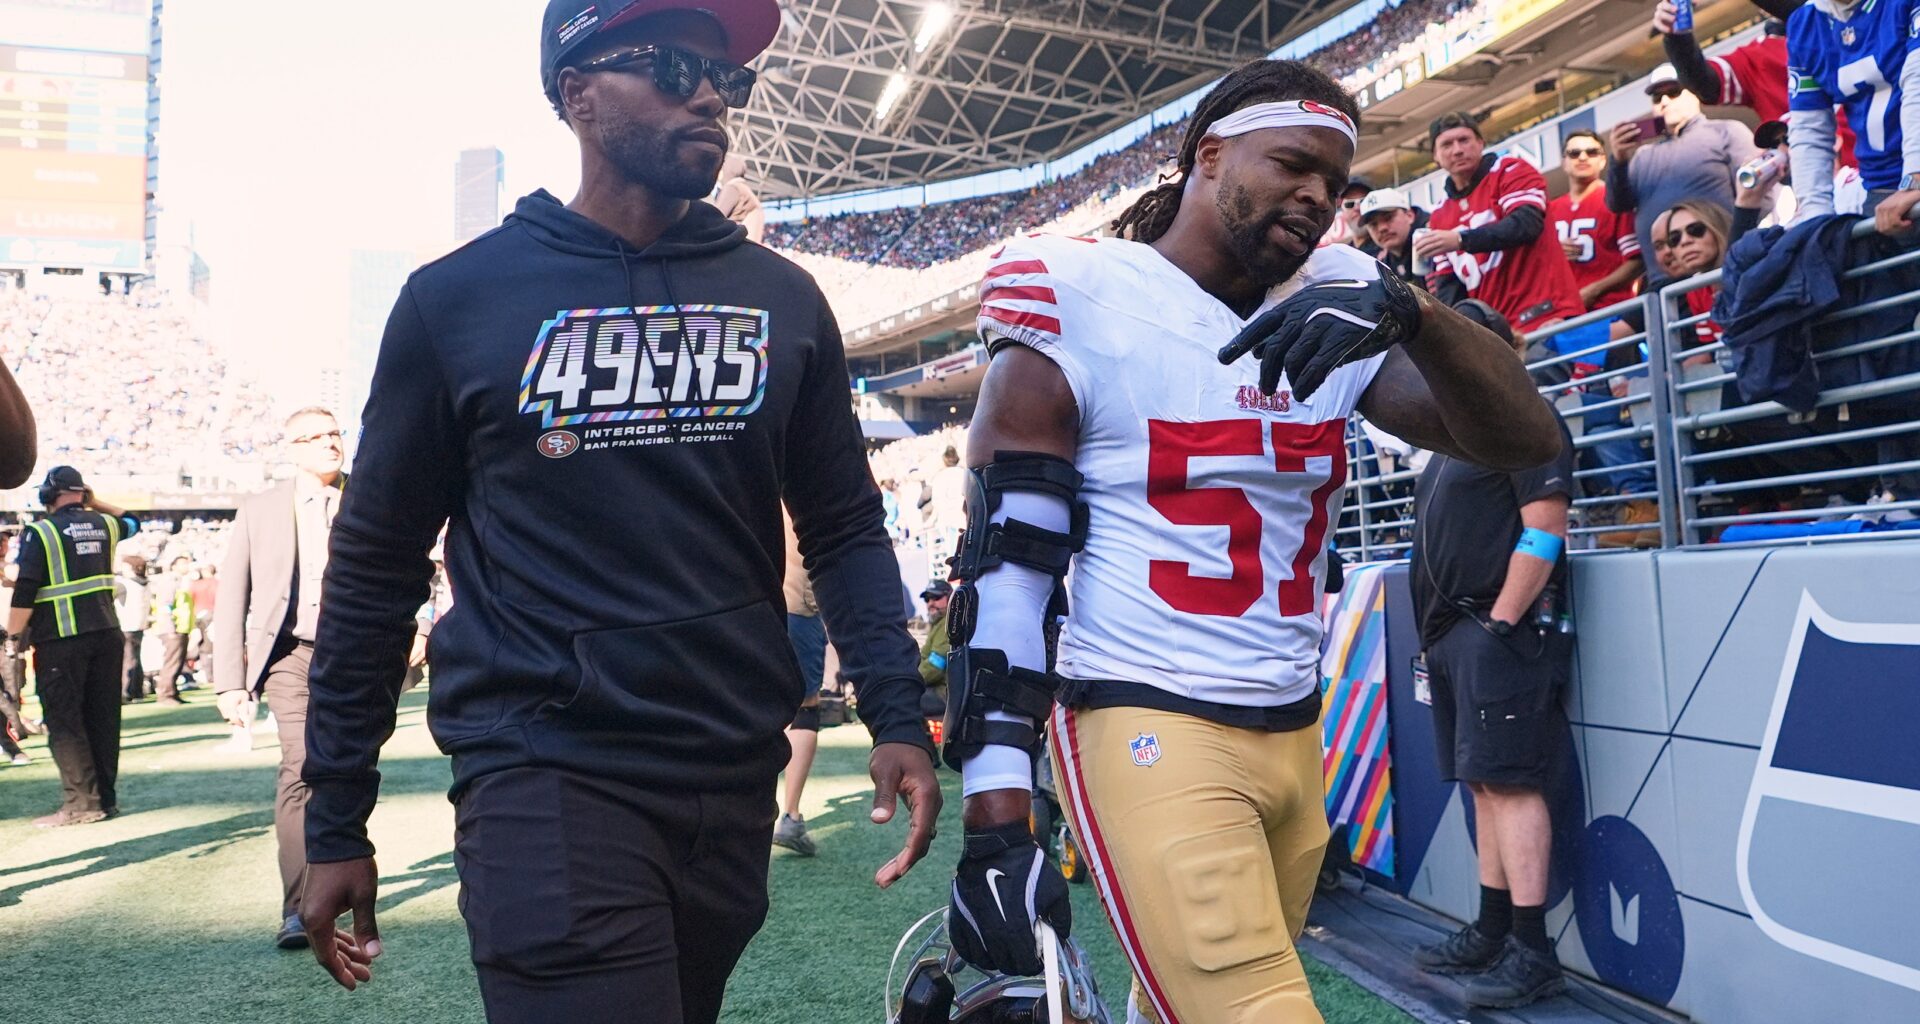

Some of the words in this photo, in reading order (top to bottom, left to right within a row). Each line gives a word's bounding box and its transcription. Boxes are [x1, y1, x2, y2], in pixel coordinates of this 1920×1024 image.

[1837, 55, 1892, 152] 7
[536, 316, 757, 410] 49ERS
[584, 441, 609, 450] SAN
[680, 434, 734, 443] FOOTBALL
[681, 422, 746, 432] CANCER
[1147, 418, 1347, 618] 57
[1136, 746, 1157, 761] NFL
